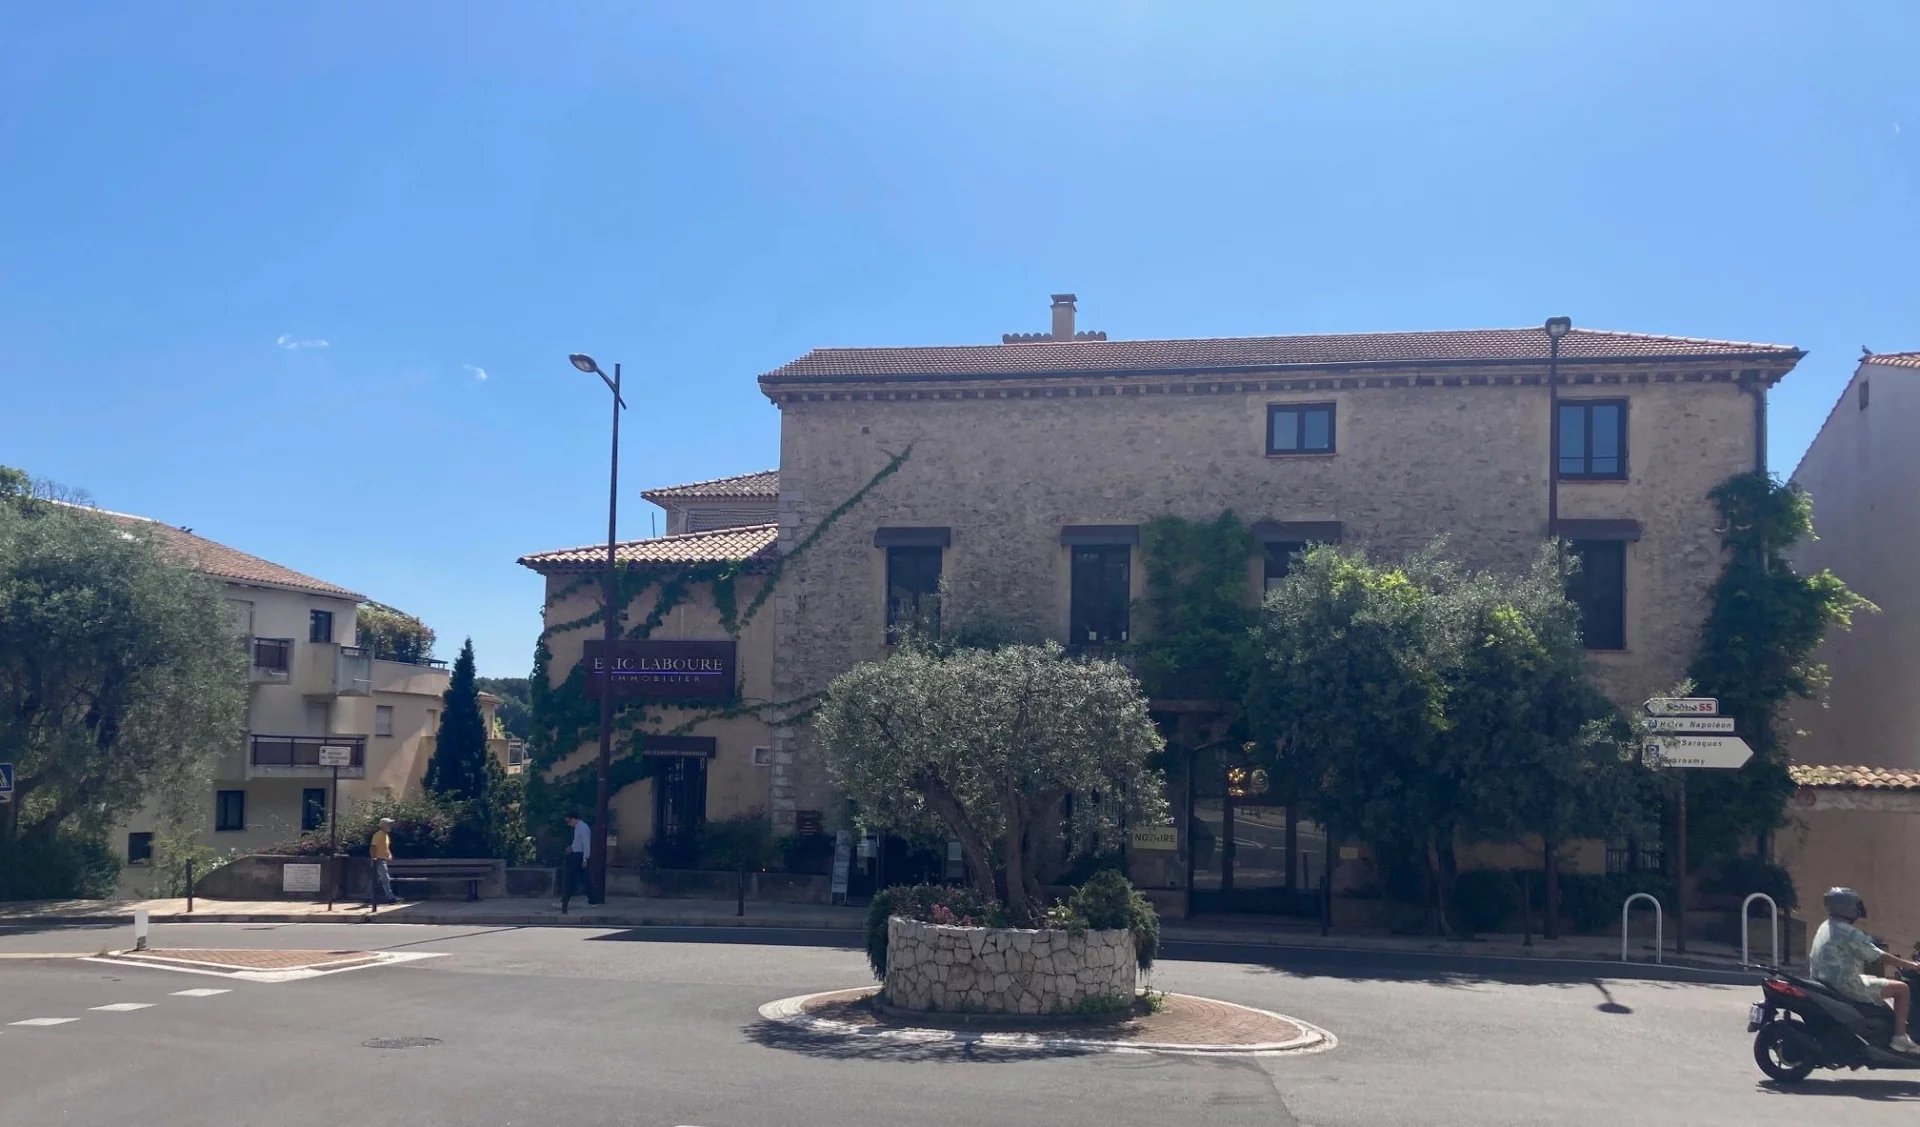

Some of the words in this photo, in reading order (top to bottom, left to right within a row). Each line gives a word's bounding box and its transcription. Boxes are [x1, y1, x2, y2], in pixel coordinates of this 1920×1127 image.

[594, 657, 634, 670] EIC
[641, 658, 723, 671] LABOURE
[1699, 703, 1713, 711] 55
